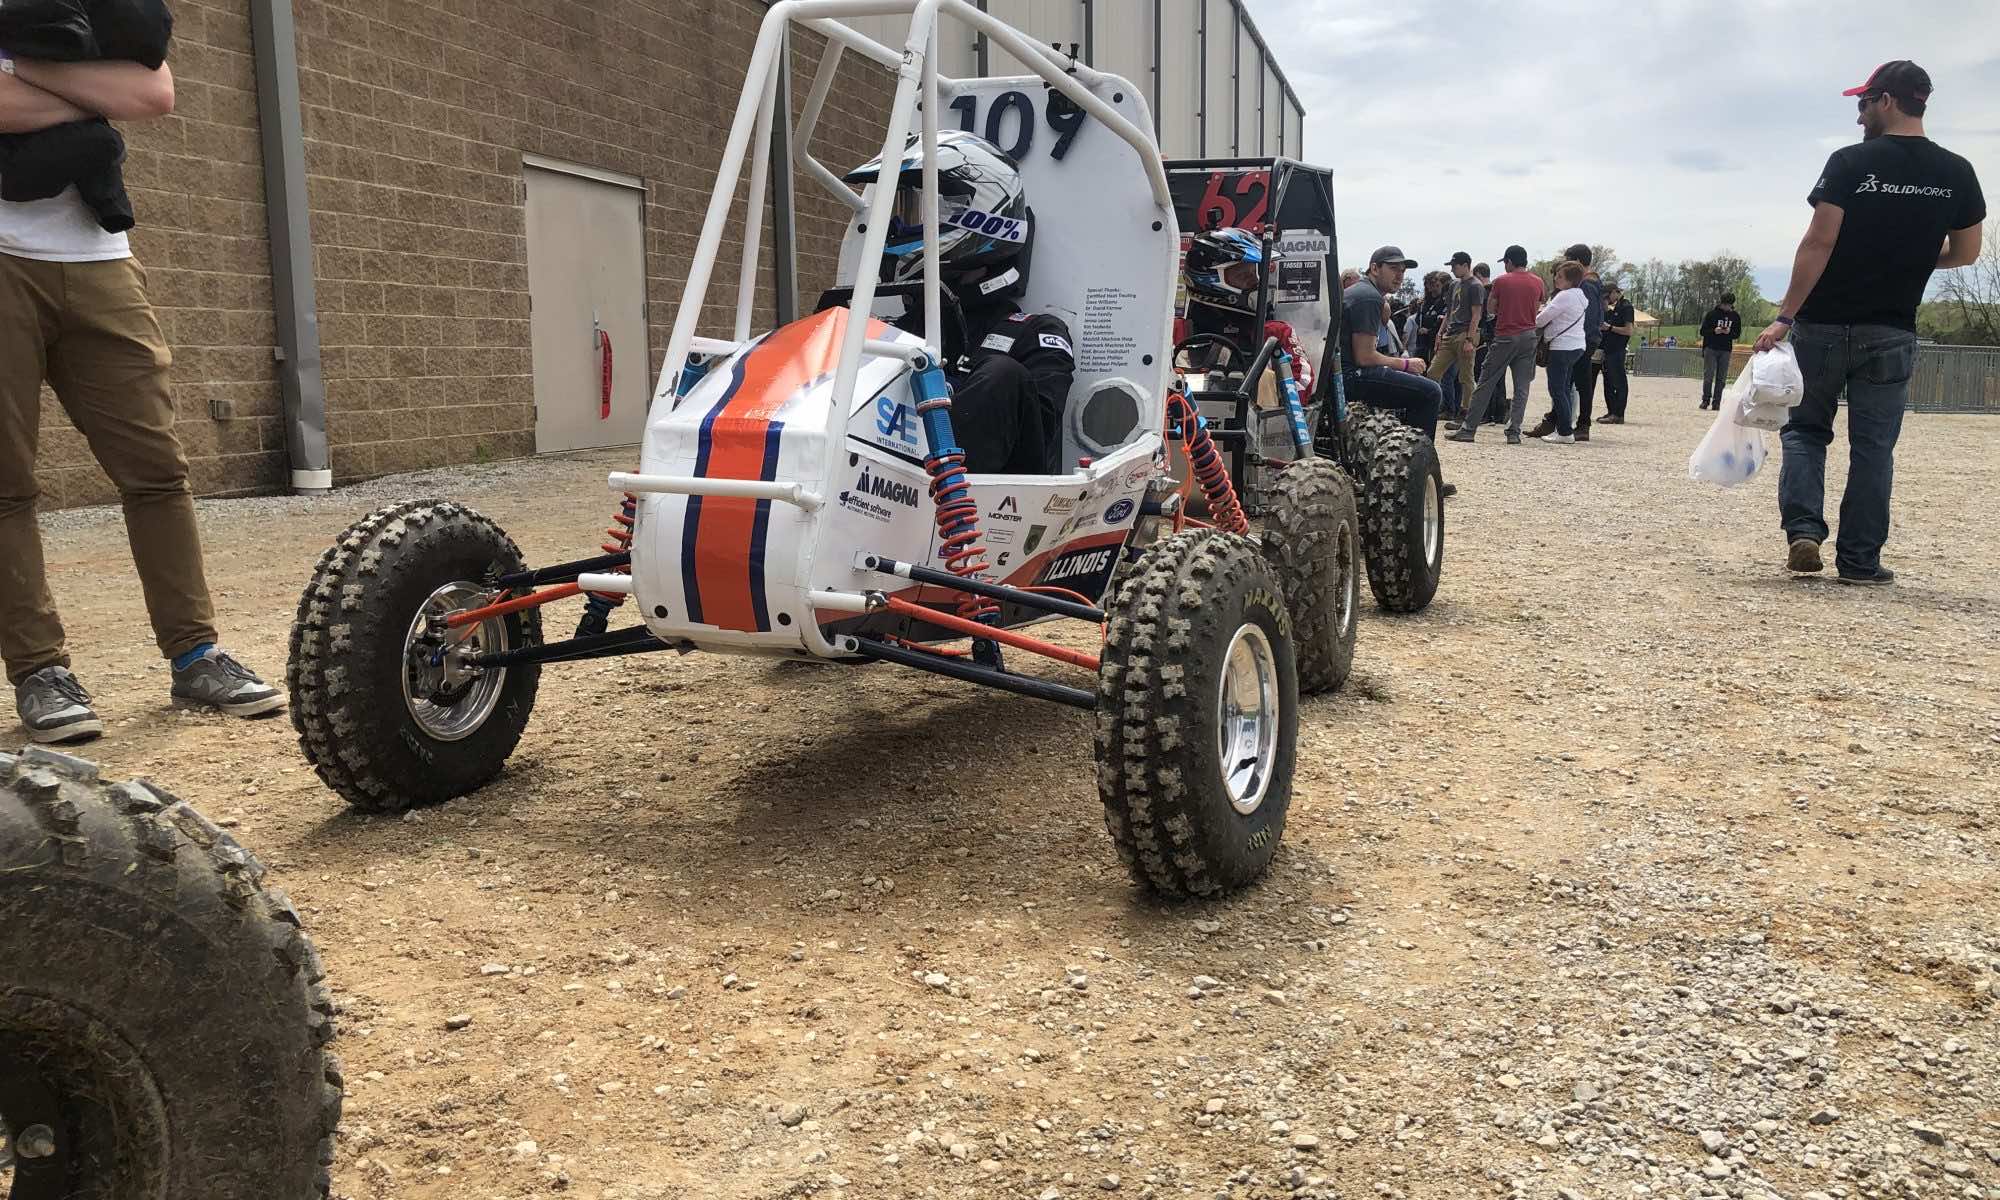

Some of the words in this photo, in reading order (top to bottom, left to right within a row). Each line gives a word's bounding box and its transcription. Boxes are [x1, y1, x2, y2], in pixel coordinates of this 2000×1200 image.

[950, 90, 1087, 160] 109
[1198, 172, 1276, 234] 62
[1880, 183, 1953, 198] SOLIDWORKS
[947, 211, 1019, 240] 100%
[1272, 240, 1328, 253] MAGNA
[877, 397, 918, 445] SAE
[876, 435, 920, 456] INTERNATIONAL
[849, 495, 870, 510] efficient
[870, 504, 892, 518] software
[871, 476, 919, 508] MAGNA
[988, 512, 1022, 522] MONSTER
[1043, 550, 1112, 582] ILLINOIS
